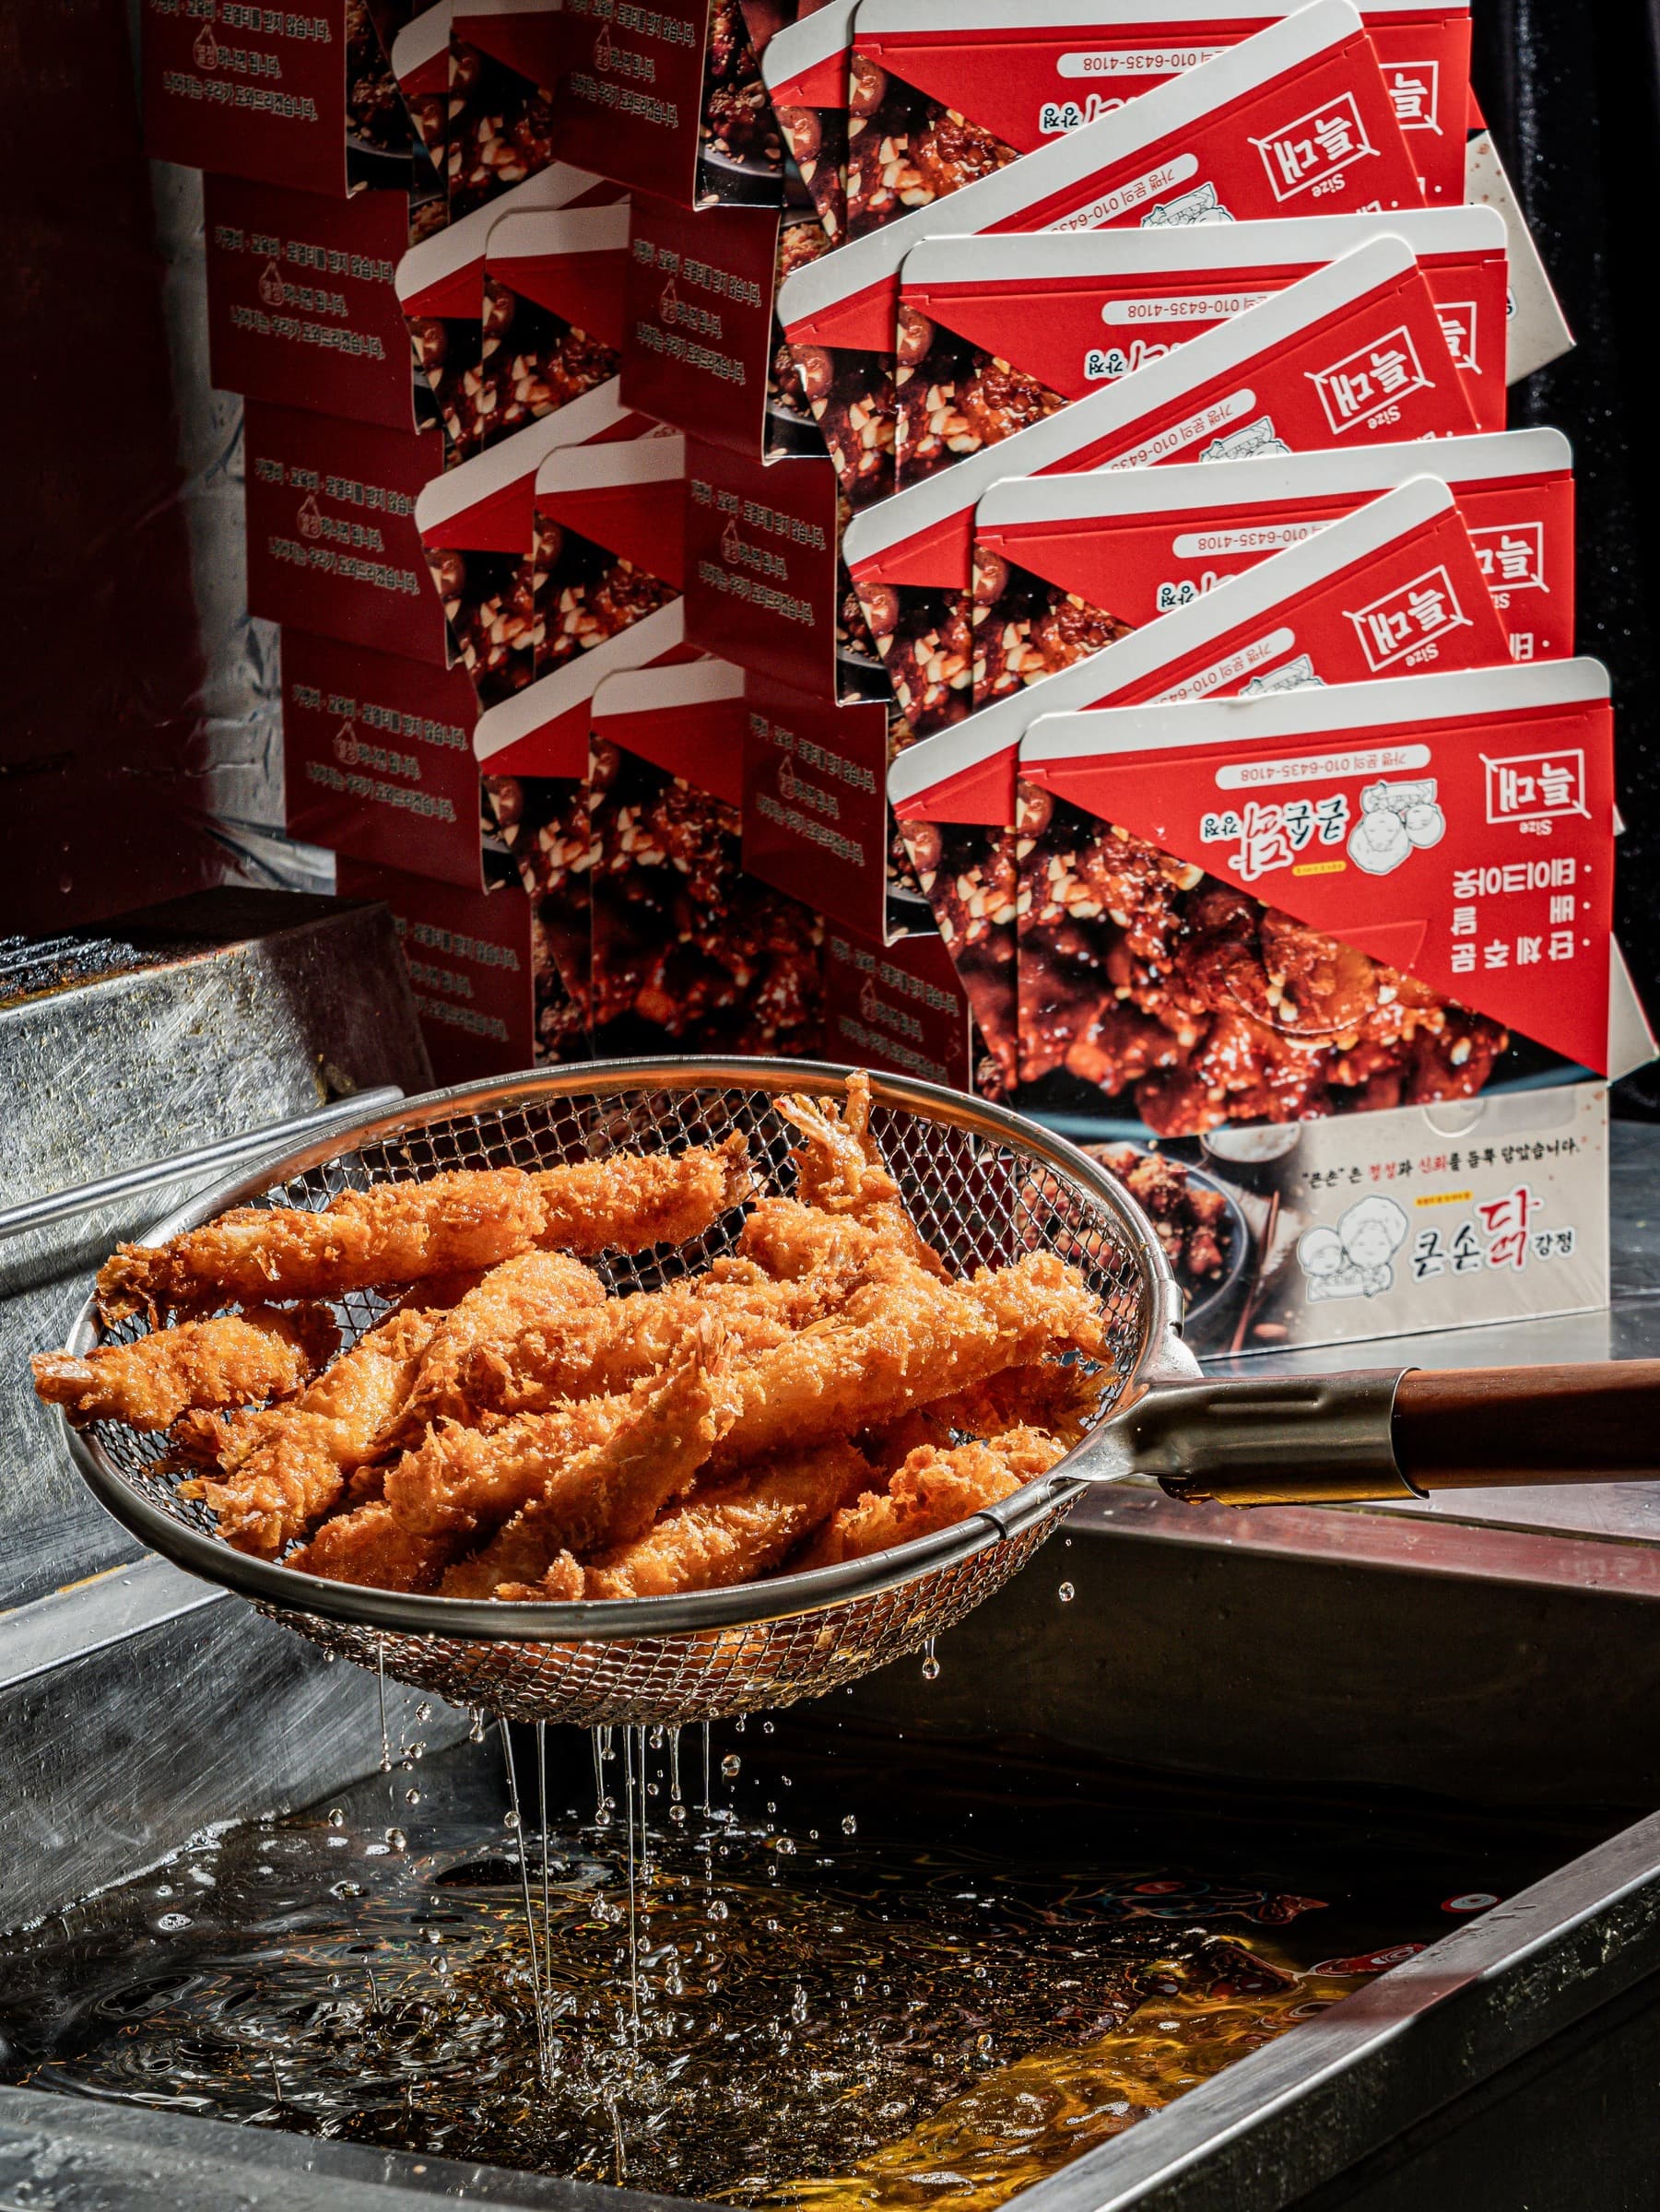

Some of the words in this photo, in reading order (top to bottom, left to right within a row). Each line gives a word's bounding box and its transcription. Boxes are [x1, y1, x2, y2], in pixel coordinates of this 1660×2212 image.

[1083, 53, 1196, 71] 010-6435-4108
[1388, 73, 1428, 119] 특
[1273, 116, 1354, 184] 특대
[1148, 169, 1175, 191] 가맹
[1311, 173, 1346, 197] Size
[1120, 182, 1147, 206] 문의
[1127, 299, 1240, 318] 010-6435-4108
[1329, 349, 1410, 418] 특대
[1207, 404, 1233, 427] 가맹
[1366, 405, 1401, 429] Size
[1179, 417, 1206, 441] 문의
[1197, 527, 1307, 550] 010-6435-4108
[1368, 589, 1448, 655] 특대
[1405, 642, 1440, 666] Size
[1219, 656, 1245, 679] 문의
[1241, 759, 1350, 782] 010-6435-4108
[1353, 754, 1379, 771] 문의
[1382, 751, 1407, 767] 가맹
[1499, 762, 1575, 813] 특대
[1519, 819, 1552, 835] Size
[1453, 857, 1575, 900] 테이크아웃
